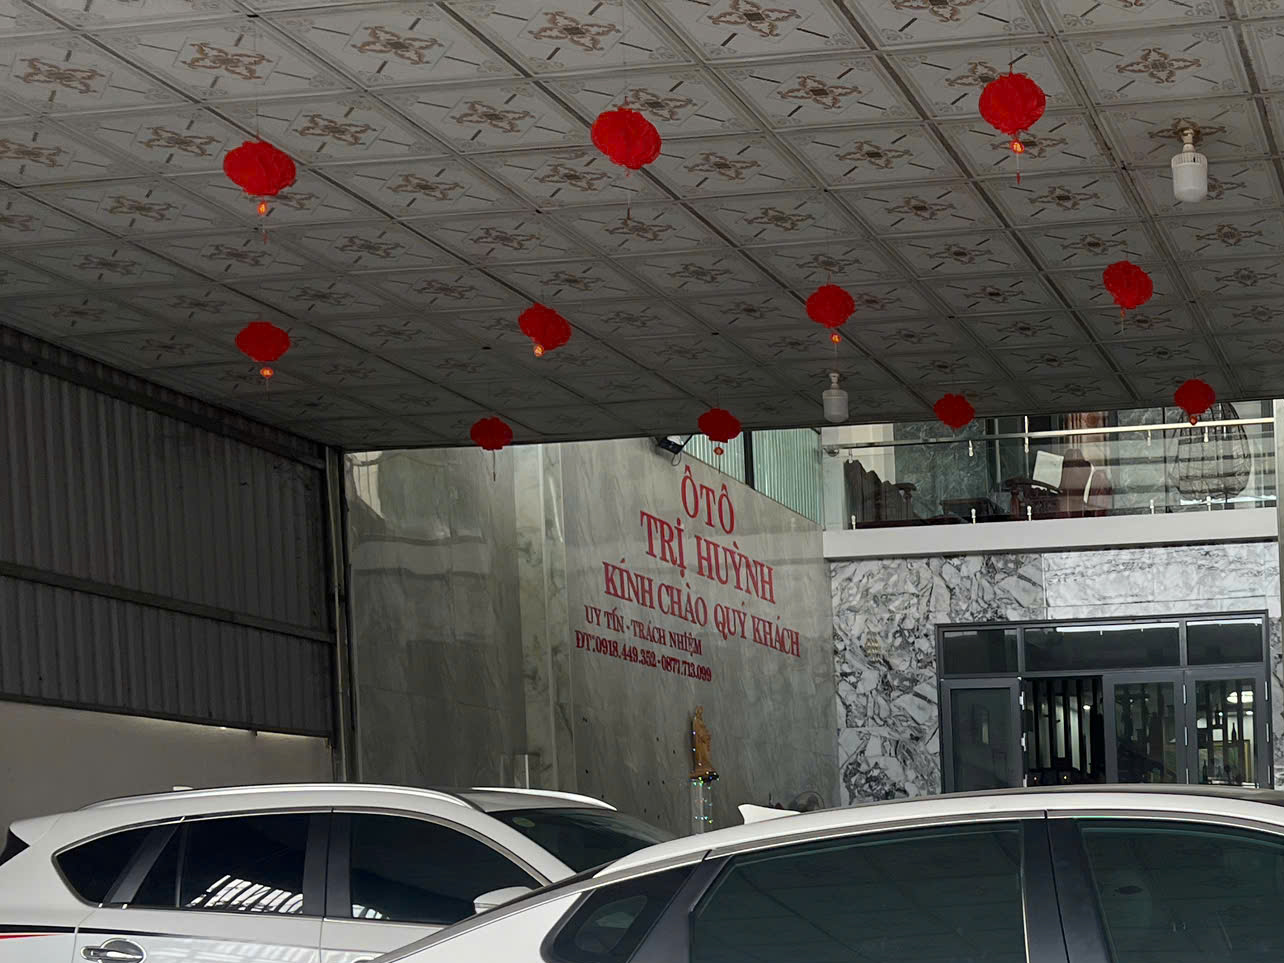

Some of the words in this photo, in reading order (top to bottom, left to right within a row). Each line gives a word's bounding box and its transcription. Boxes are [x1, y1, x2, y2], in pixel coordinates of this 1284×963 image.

[640, 510, 687, 578] TRỊ
[695, 535, 776, 604] HUỲNH
[584, 605, 601, 626] UY
[604, 607, 624, 633] TÍN
[630, 619, 666, 646] TRÁCH
[669, 631, 703, 657] NHIỆM
[602, 558, 655, 610] KÍNH
[657, 583, 707, 627] CHÀO
[714, 601, 748, 640] QUÝ
[751, 615, 800, 658] KHÁCH
